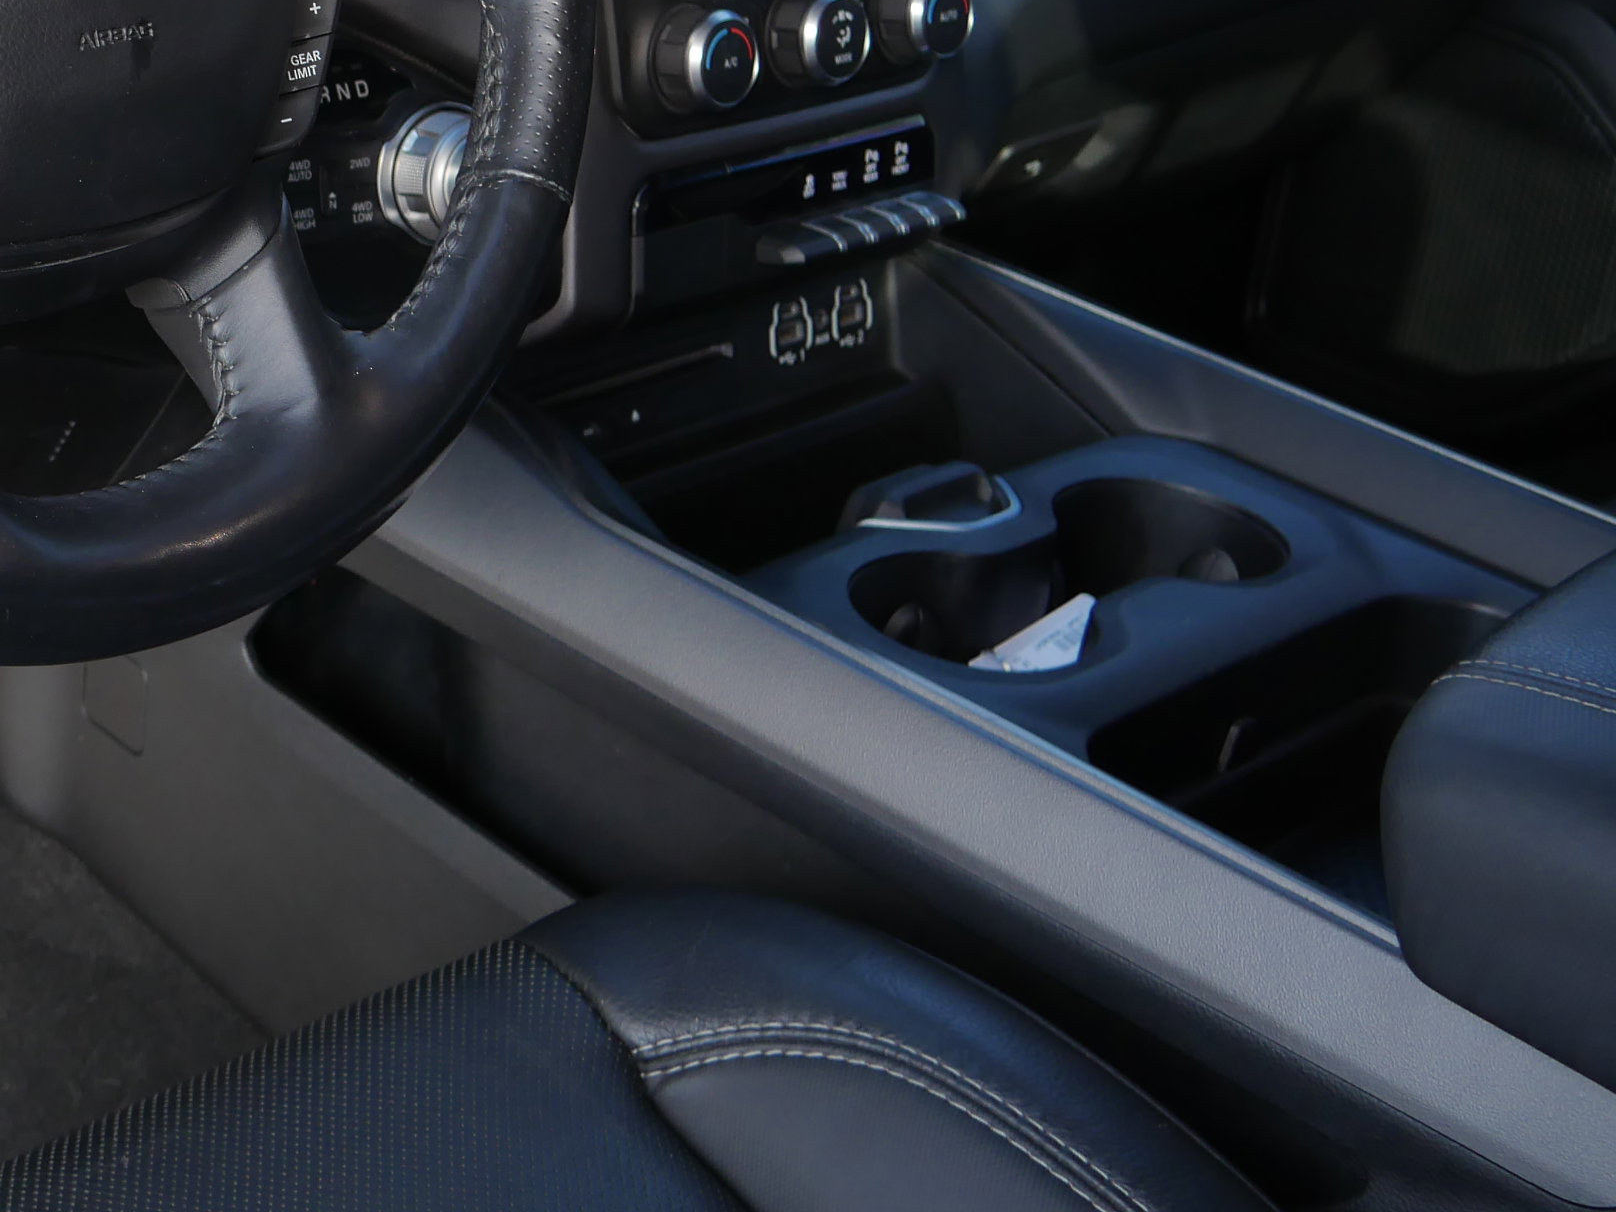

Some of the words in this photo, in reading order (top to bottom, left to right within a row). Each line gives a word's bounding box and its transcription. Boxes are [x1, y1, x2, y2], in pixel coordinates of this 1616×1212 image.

[79, 22, 155, 52] AIRBAG
[290, 49, 321, 66] GEAR
[287, 64, 317, 81] LIMIT
[335, 81, 352, 101] N
[354, 79, 370, 98] D
[289, 159, 311, 171] 4WD
[349, 156, 371, 170] 2WD
[287, 170, 313, 183] AUTO
[352, 201, 373, 213] 4WD
[352, 212, 374, 224] LOW
